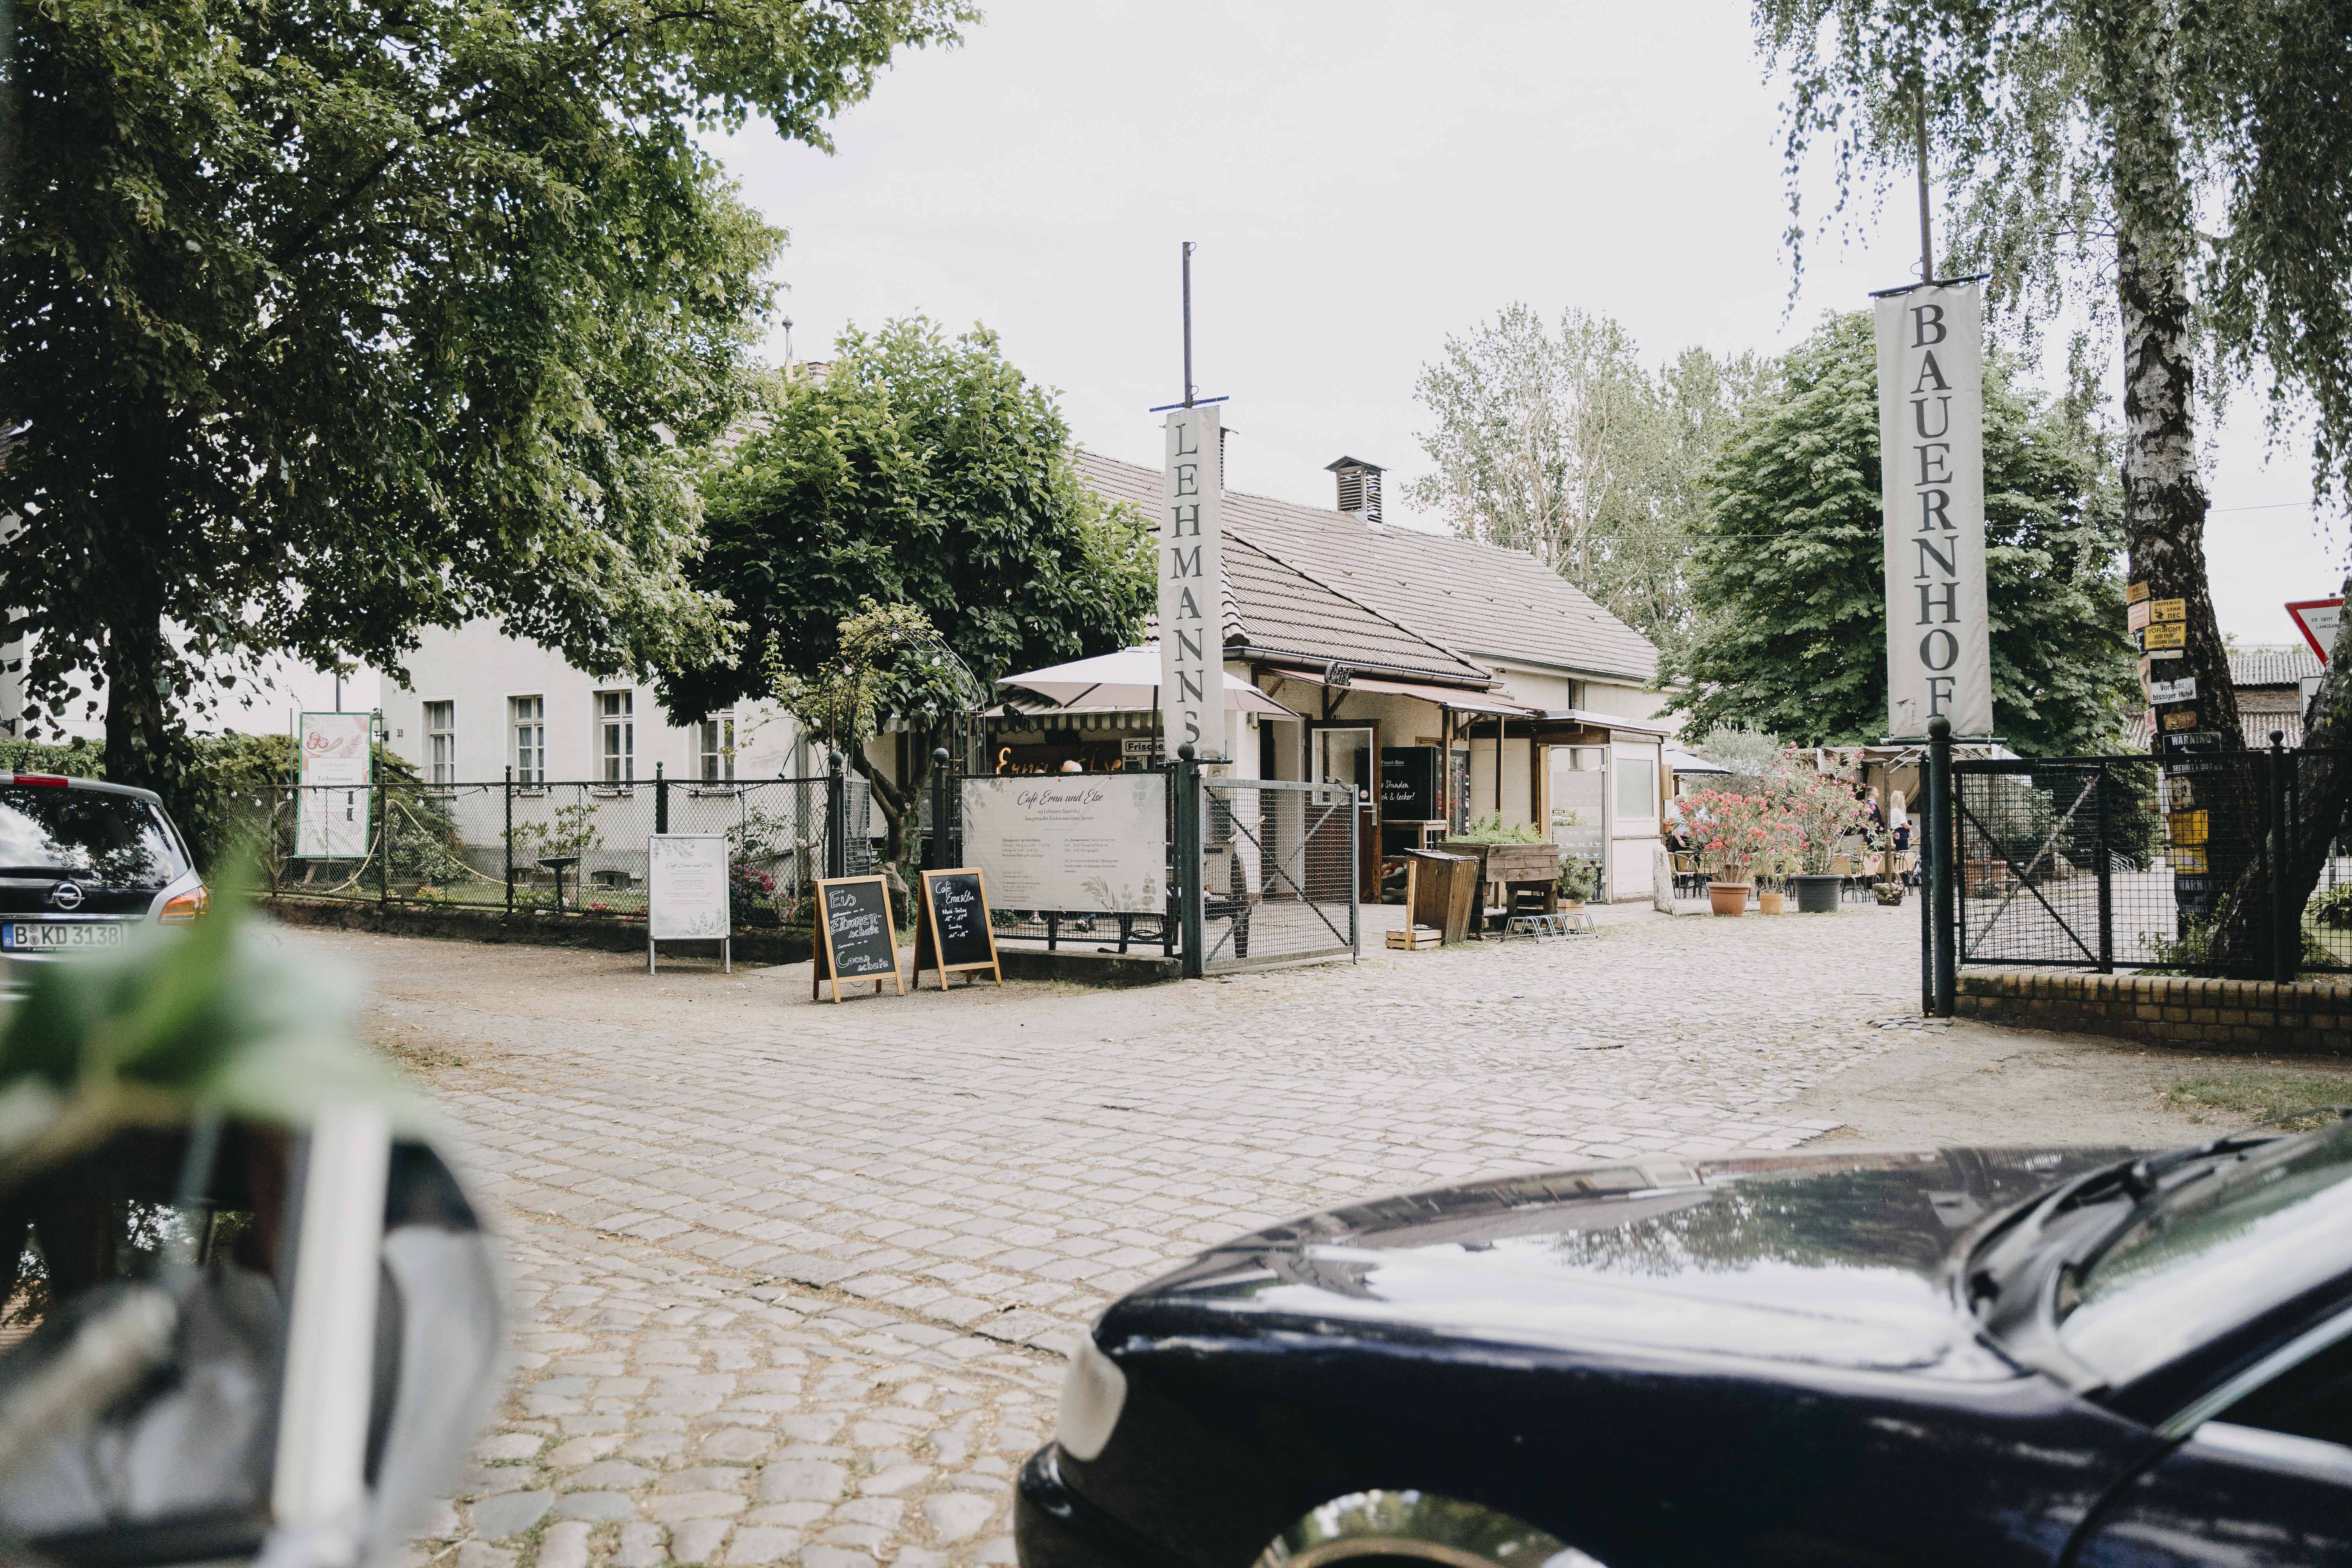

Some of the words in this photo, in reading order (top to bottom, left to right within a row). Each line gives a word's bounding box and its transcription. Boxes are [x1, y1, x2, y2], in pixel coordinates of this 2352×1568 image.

[1909, 304, 1960, 718] BAUERNHOF
[1170, 423, 1203, 744] LEHMANNS
[2160, 682, 2185, 691] Vorsicht
[2172, 734, 2211, 746] WARNING
[1385, 780, 1409, 788] Stunden
[1018, 791, 1039, 809] Café
[1040, 790, 1063, 805] Erna
[1065, 791, 1084, 802] und
[1083, 789, 1104, 804] Else
[1397, 791, 1415, 800] lecker!
[936, 881, 951, 898] Café
[829, 890, 856, 908] Eis
[15, 926, 27, 944] B
[42, 926, 67, 944] KD
[73, 927, 118, 944] 3138
[848, 925, 879, 938] schale
[836, 951, 870, 968] Cocos
